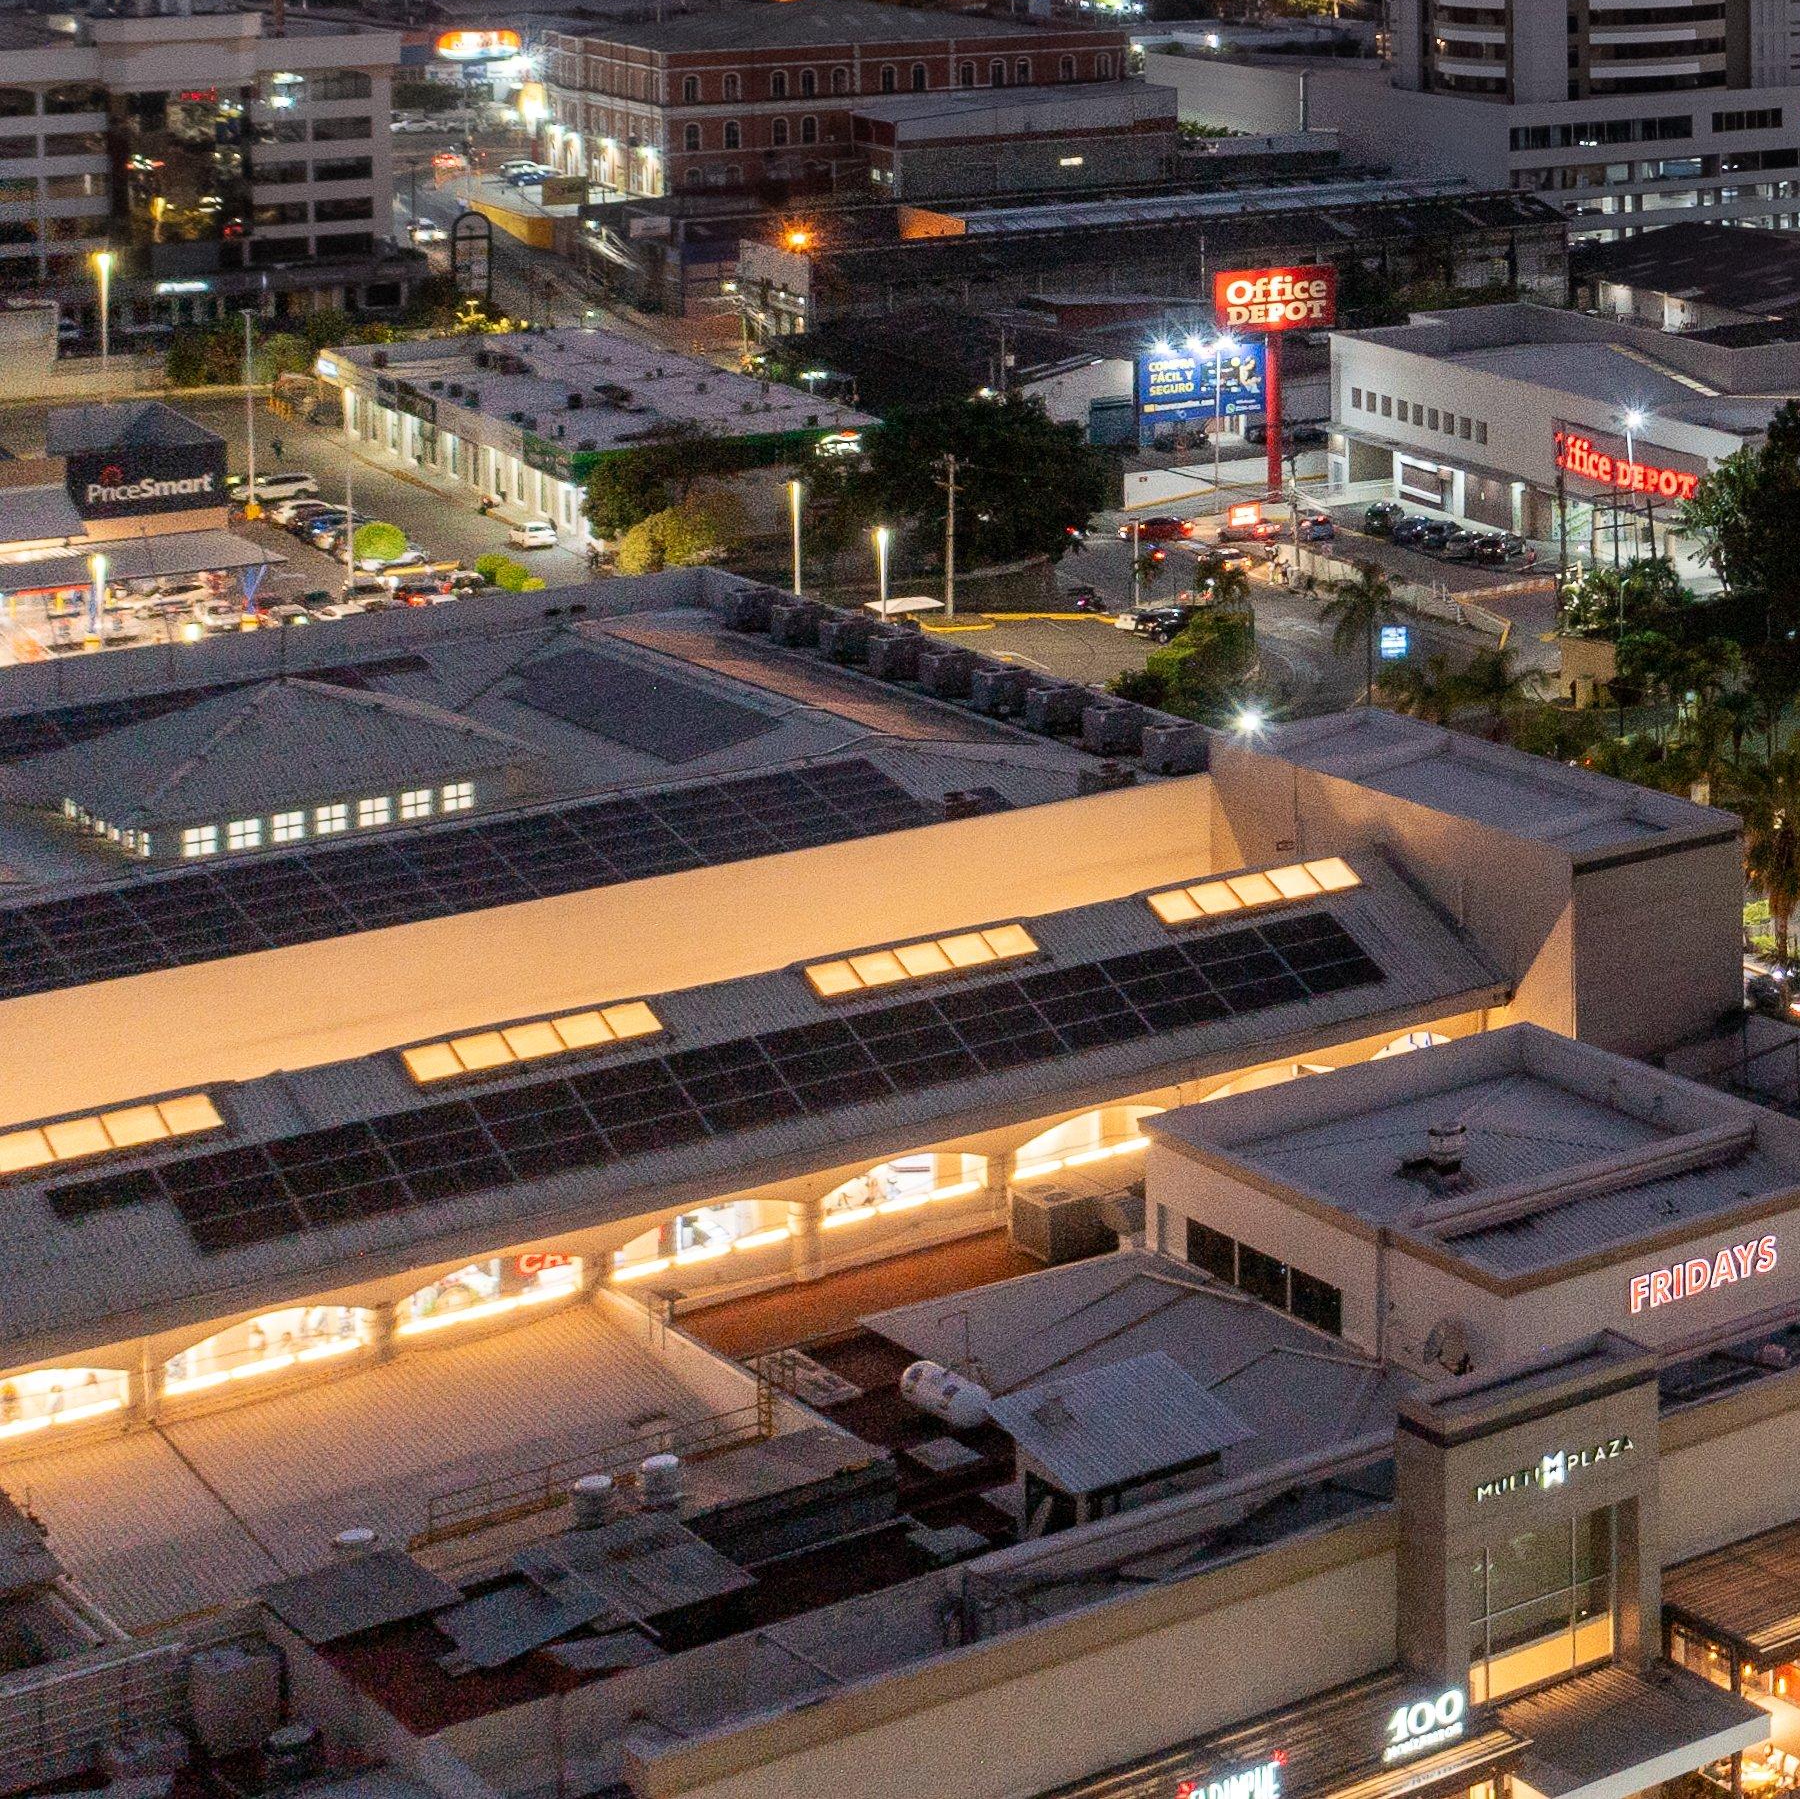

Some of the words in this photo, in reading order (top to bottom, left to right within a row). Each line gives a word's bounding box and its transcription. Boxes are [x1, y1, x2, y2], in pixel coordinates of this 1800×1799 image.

[1226, 275, 1327, 305] Office
[1226, 300, 1327, 326] DEPOT
[1149, 382, 1195, 396] SEGURO
[1615, 460, 1698, 500] DEPOT
[1630, 1235, 1777, 1314] FRIDAYS
[1387, 1689, 1464, 1745] 100
